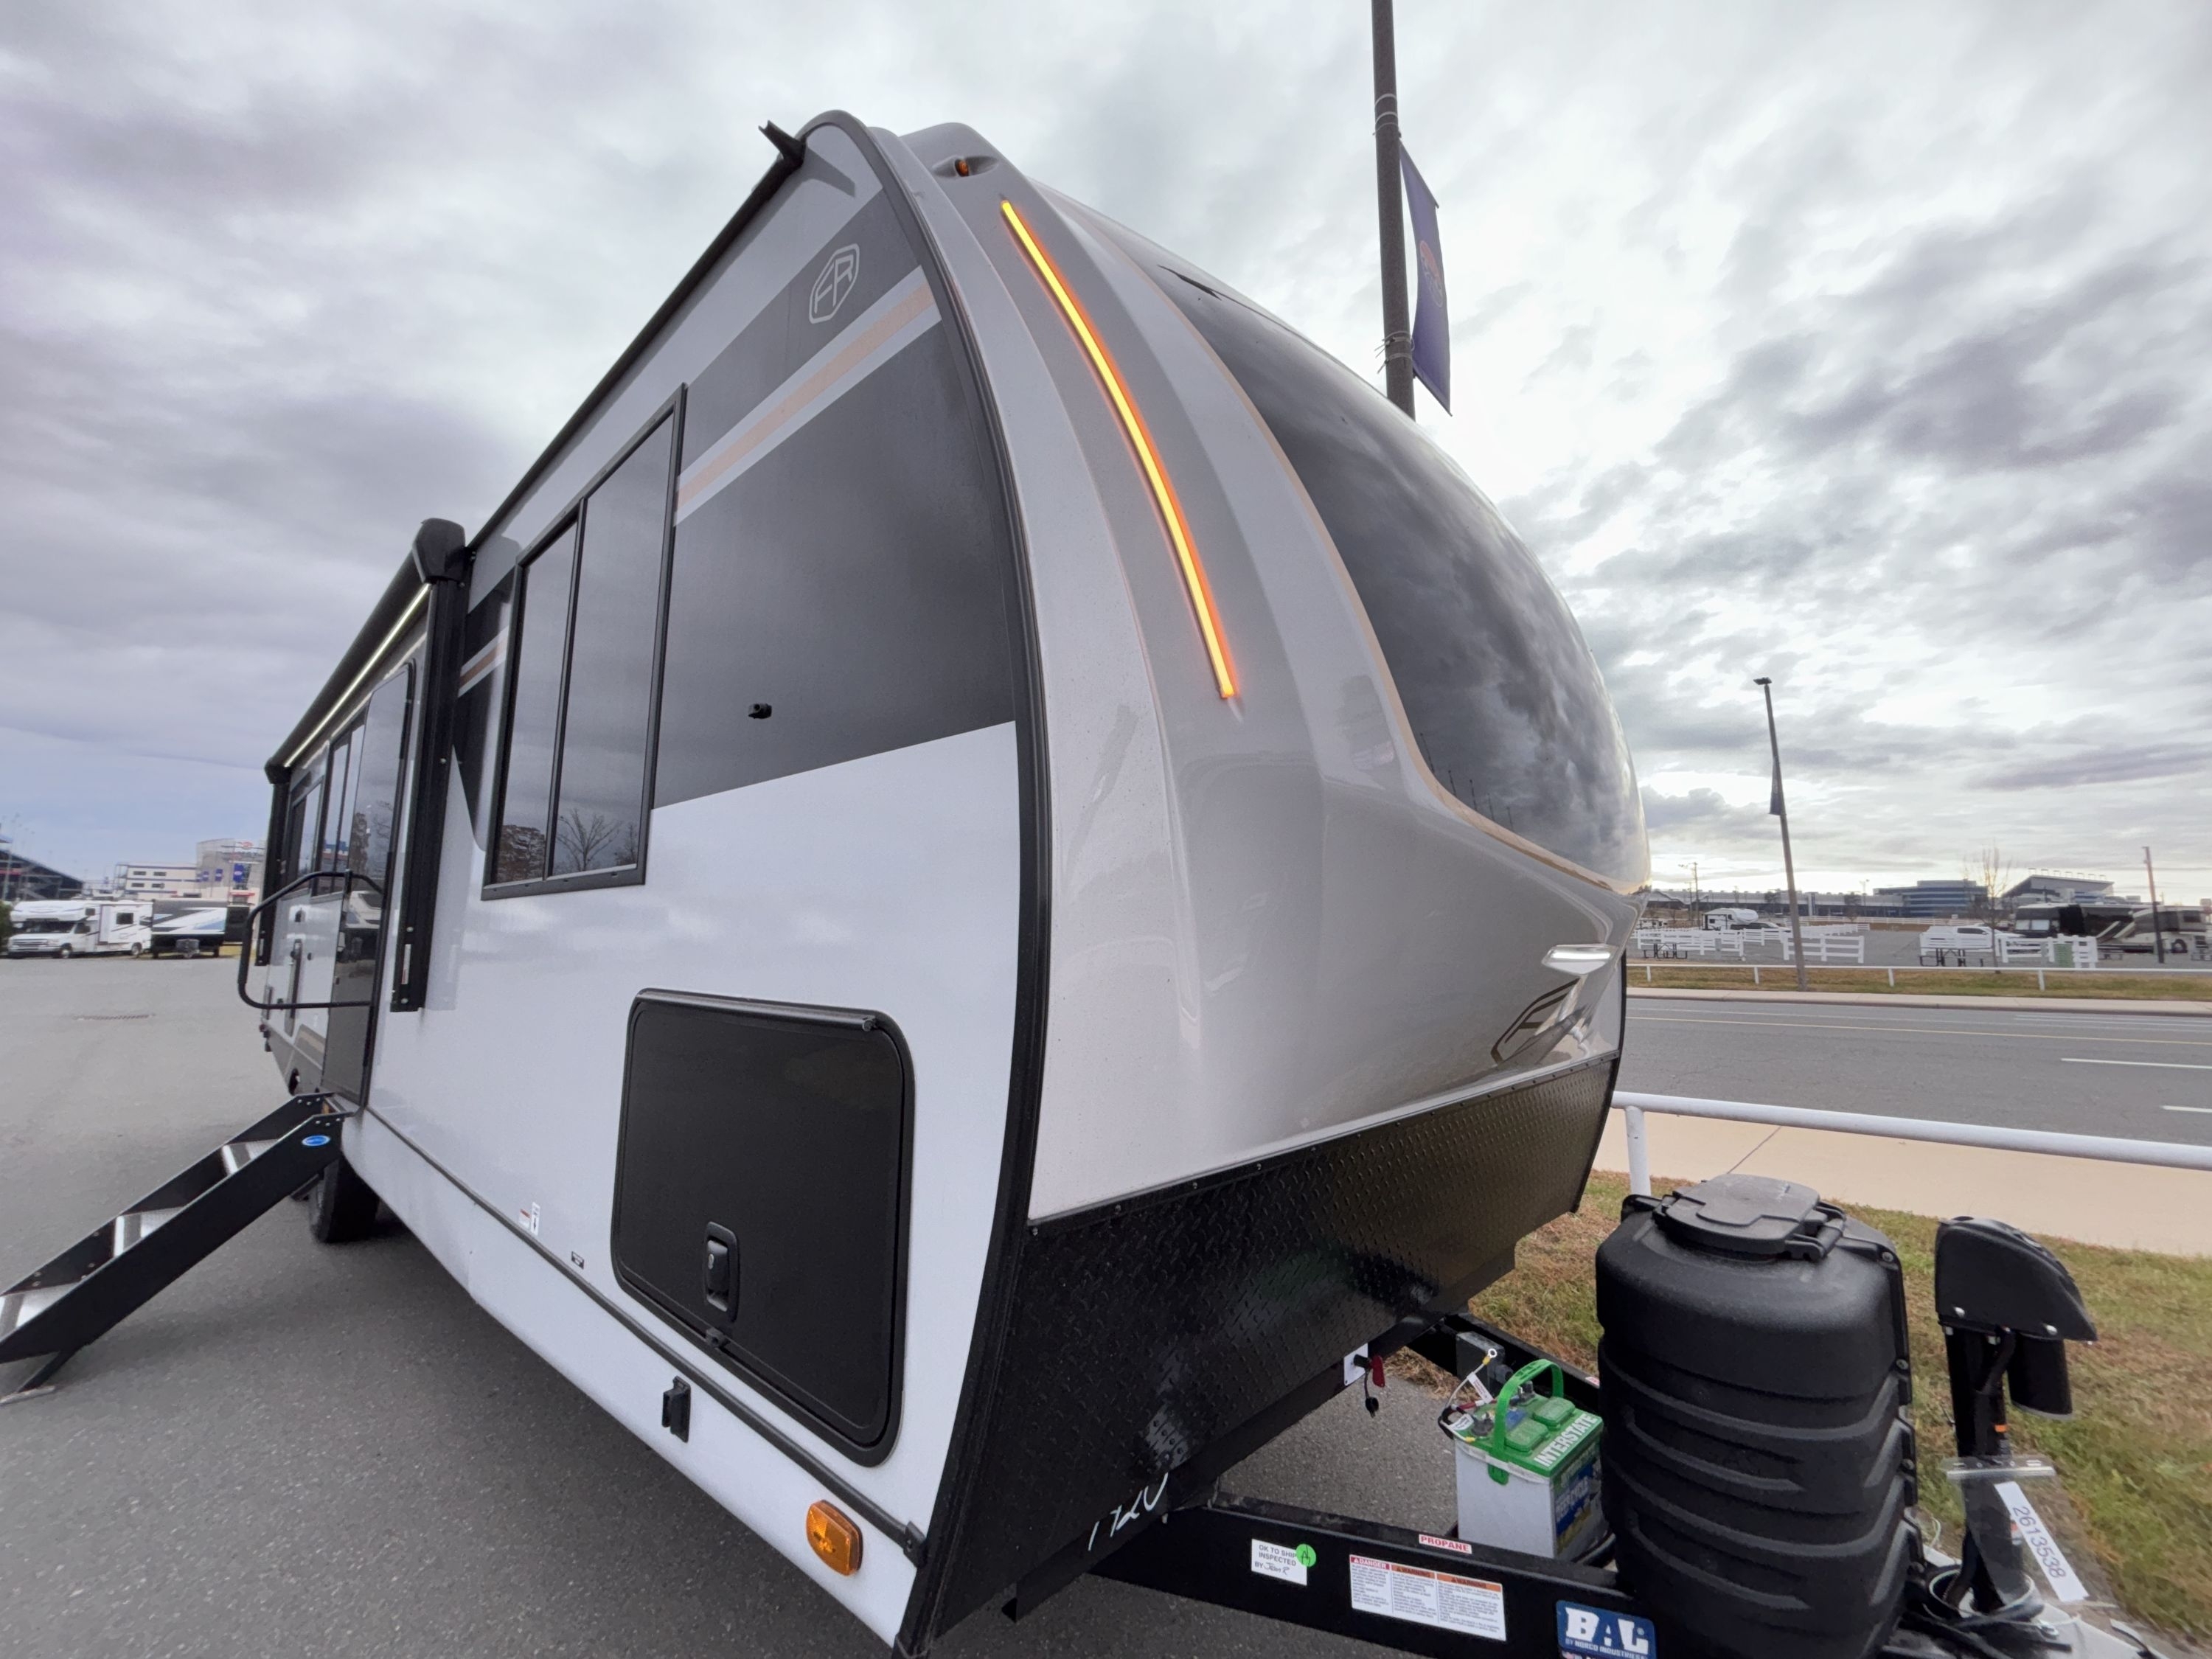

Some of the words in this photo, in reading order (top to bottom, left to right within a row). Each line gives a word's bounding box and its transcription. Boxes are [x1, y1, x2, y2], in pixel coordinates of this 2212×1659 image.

[1533, 1413, 1599, 1467] INTERSTATE
[1420, 1536, 1469, 1553] PROPANE
[2011, 1506, 2067, 1579] 2613538
[1259, 1551, 1297, 1567] INSPECTED
[1270, 1547, 1280, 1555] TO
[1281, 1550, 1297, 1558] SHIP
[1359, 1558, 1386, 1570] DANGER
[1456, 1578, 1487, 1588] WARNING
[1565, 1607, 1649, 1655] BAL
